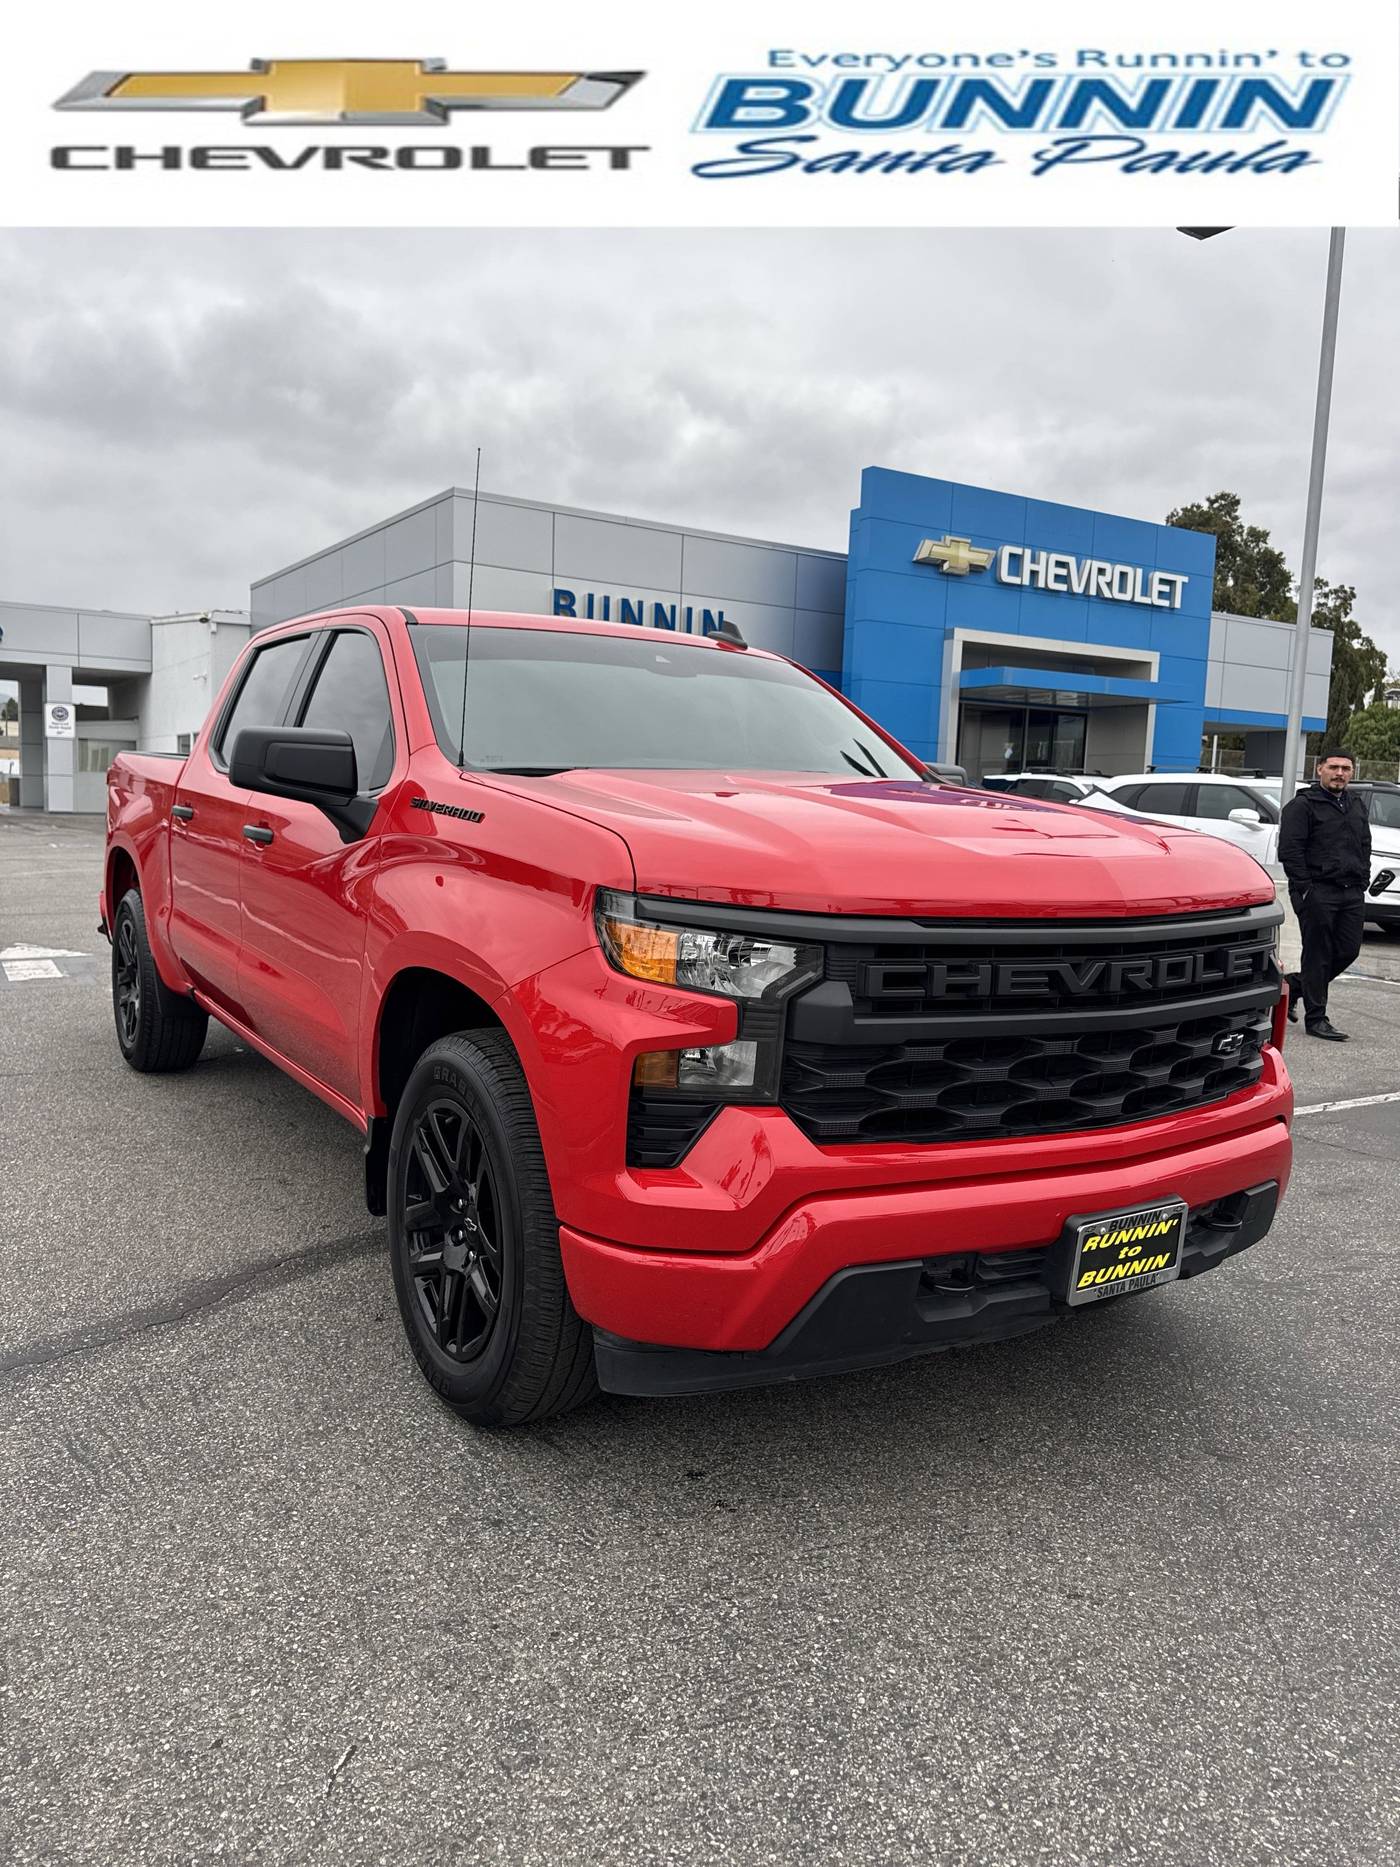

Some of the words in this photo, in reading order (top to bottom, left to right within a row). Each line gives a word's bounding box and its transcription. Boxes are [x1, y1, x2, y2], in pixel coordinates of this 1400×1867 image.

[997, 544, 1189, 609] CHEVROLET
[410, 798, 486, 824] SILVERADO
[856, 942, 1277, 998] CHEVROLET
[1108, 1210, 1163, 1232] BUNNIN
[1118, 1245, 1143, 1259] to
[1076, 1252, 1171, 1289] BUNNIN
[1096, 1280, 1126, 1299] SANTA
[1128, 1272, 1156, 1291] PAULA
